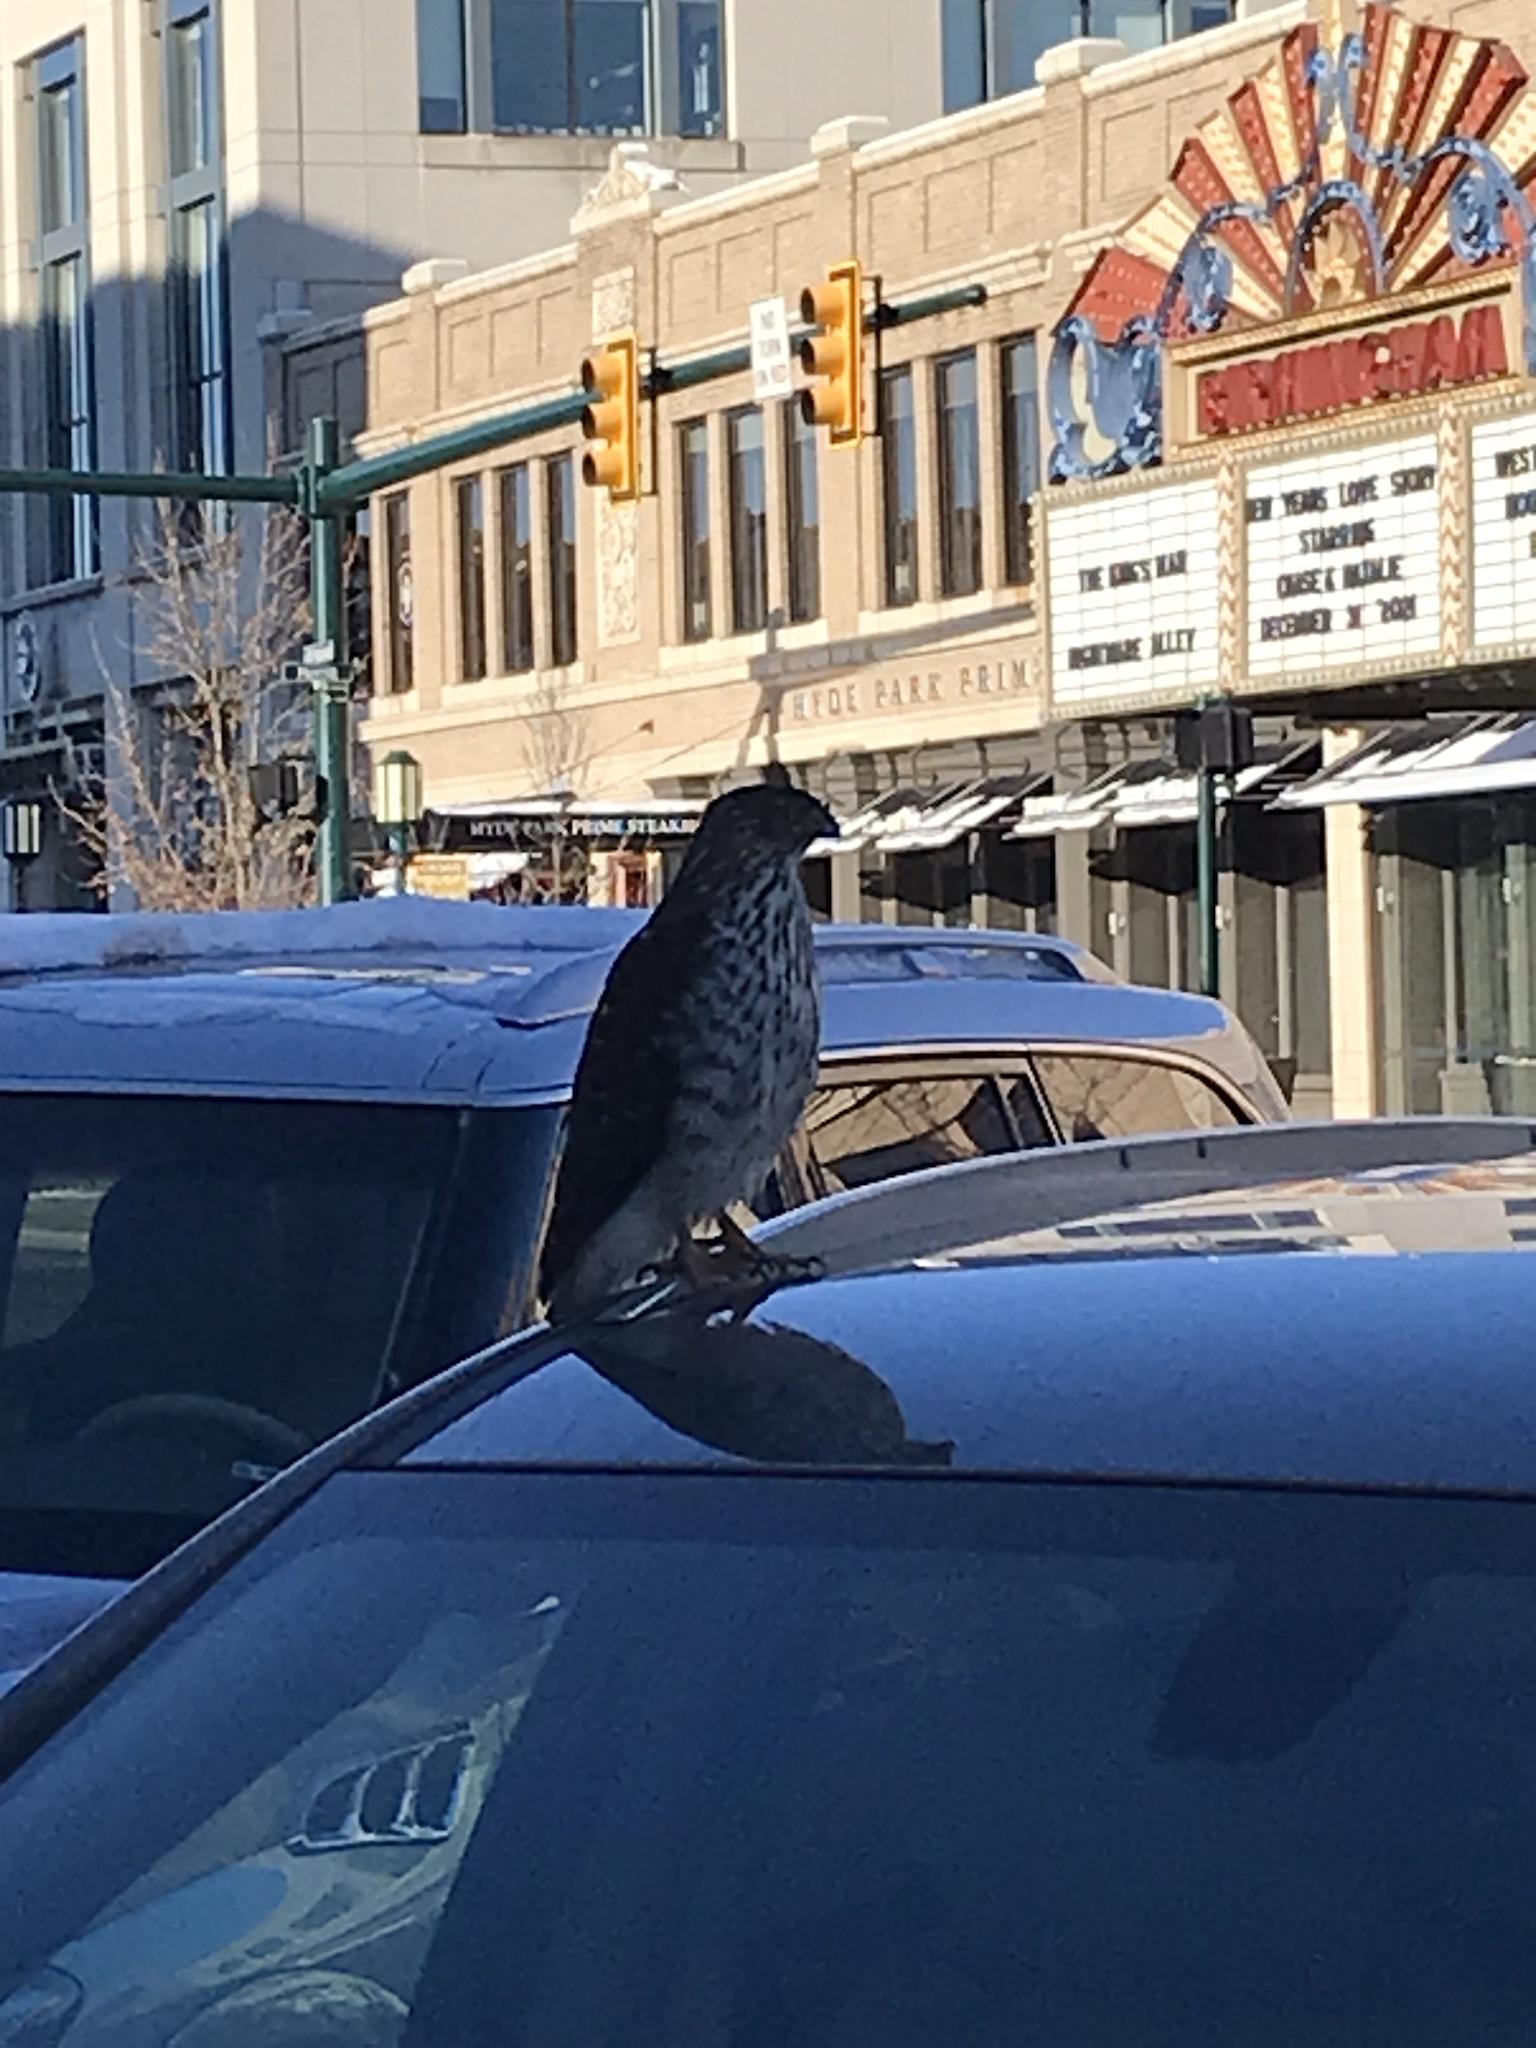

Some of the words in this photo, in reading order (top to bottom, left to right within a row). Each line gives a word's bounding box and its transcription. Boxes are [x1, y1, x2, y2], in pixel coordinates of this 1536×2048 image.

[1339, 475, 1378, 507] LOVE
[1079, 566, 1104, 593] THE
[1151, 627, 1196, 657] ALLEY
[793, 684, 858, 721] HYDE
[874, 672, 941, 709] PARK
[572, 818, 626, 836] PRIME
